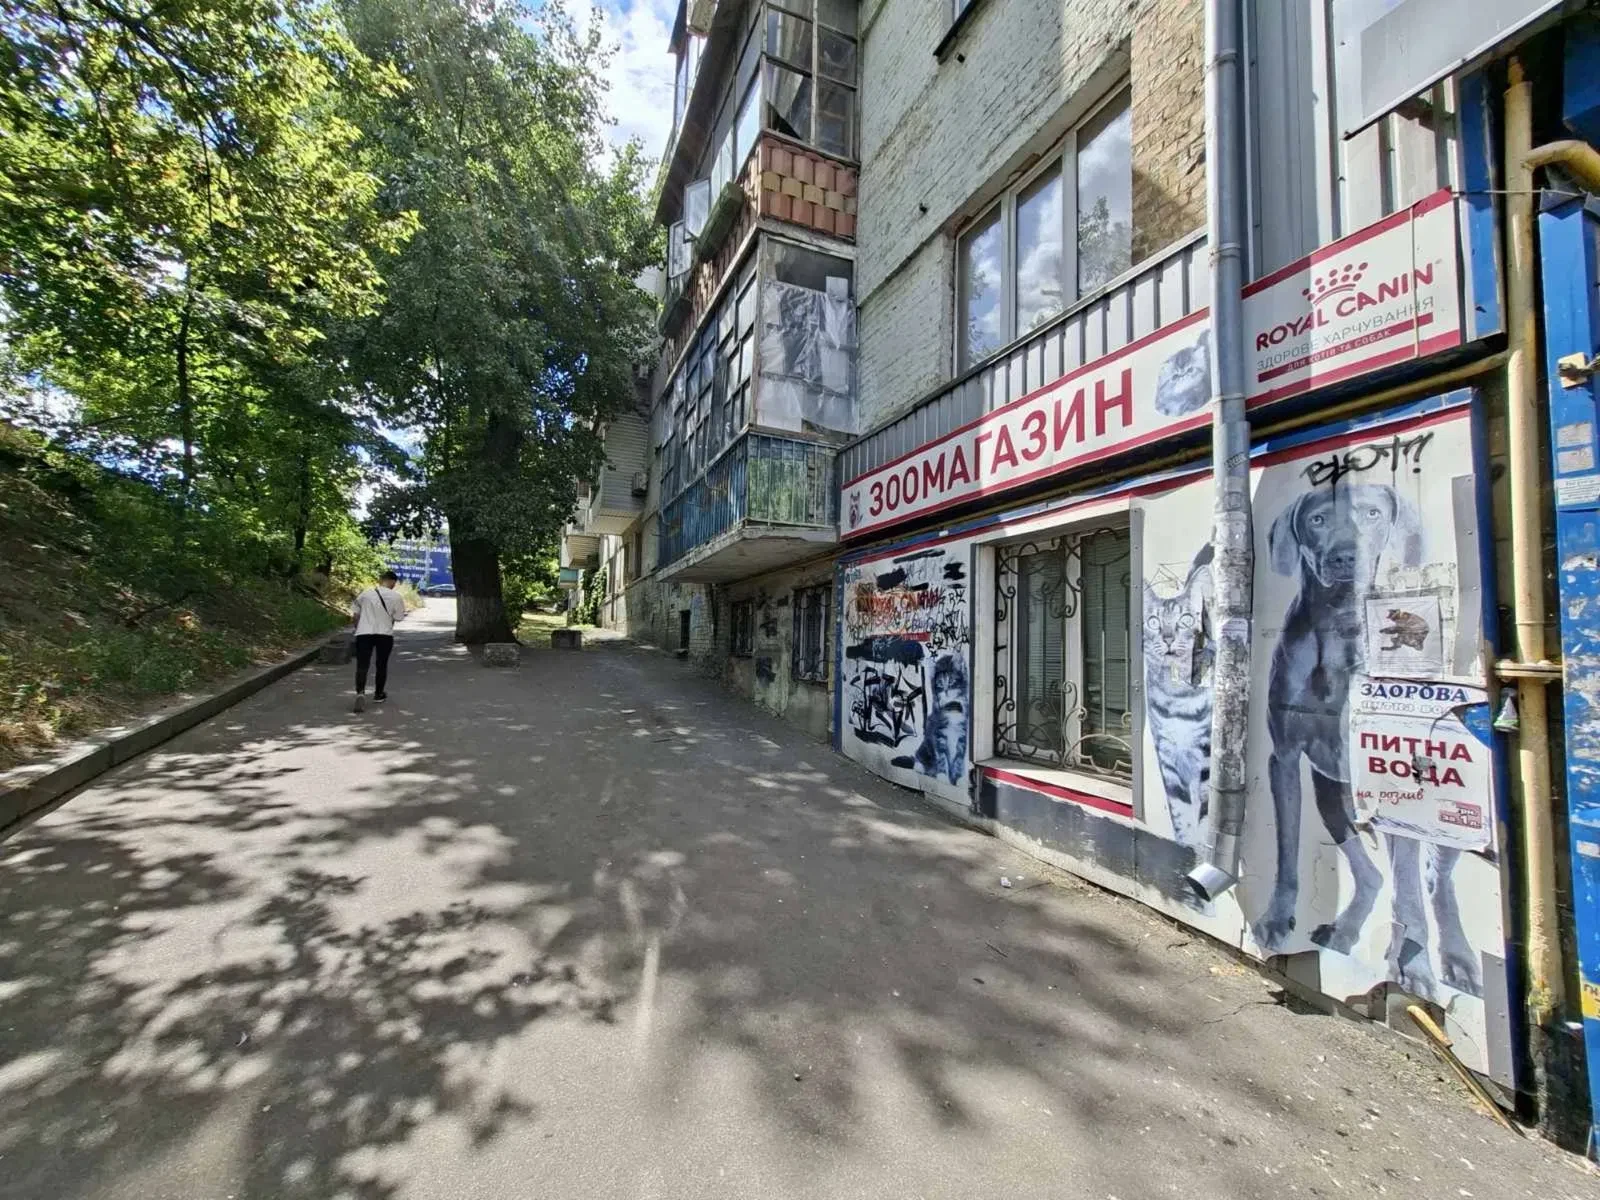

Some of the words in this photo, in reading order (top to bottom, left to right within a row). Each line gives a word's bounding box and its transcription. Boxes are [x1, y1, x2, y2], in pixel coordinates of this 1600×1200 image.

[1256, 310, 1330, 351] ROYAL
[1336, 263, 1433, 317] CANIN
[1257, 338, 1320, 371] ЗДОРОВЕ
[1323, 296, 1434, 345] ХАРЧУВАННЯ
[869, 368, 1133, 517] ЗООМАГАЗИН
[1360, 683, 1468, 702] ЗДОРОВА
[1360, 732, 1473, 763] ПИТНА
[1356, 788, 1373, 799] на
